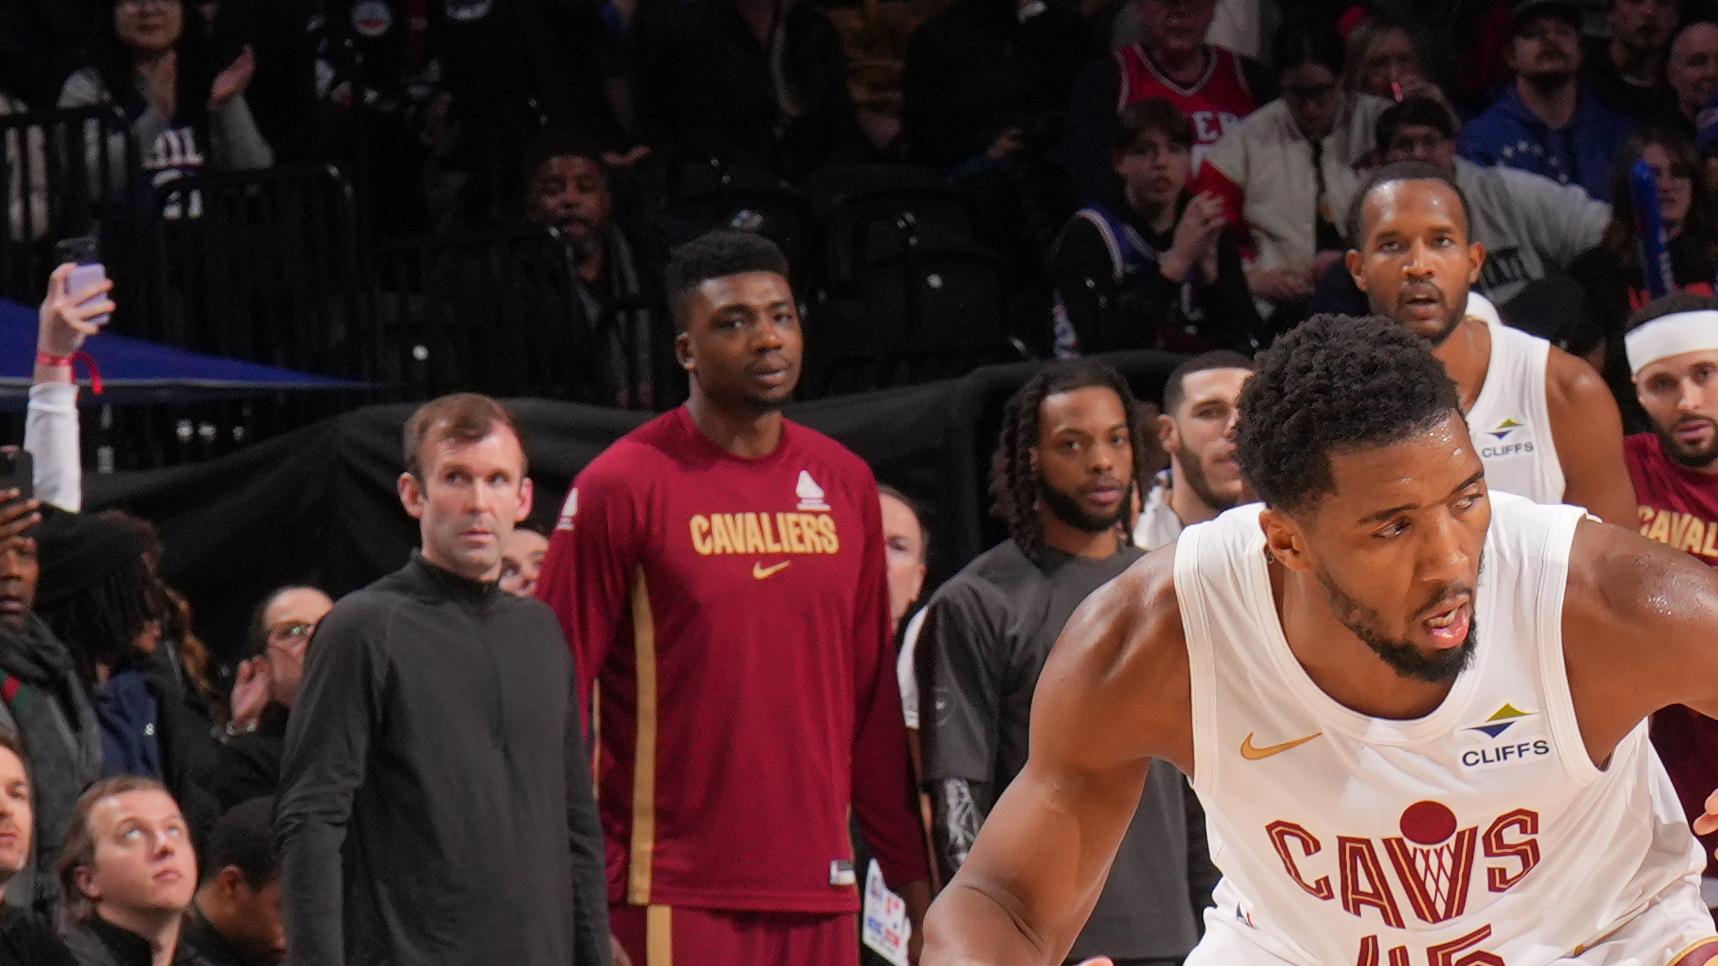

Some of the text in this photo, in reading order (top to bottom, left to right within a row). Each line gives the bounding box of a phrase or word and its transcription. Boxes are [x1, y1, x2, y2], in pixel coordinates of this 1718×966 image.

[1480, 441, 1535, 458] CLIFFS
[689, 512, 840, 555] CAVALIERS
[1461, 740, 1550, 767] CLIFFS
[1264, 807, 1541, 930] CAVS
